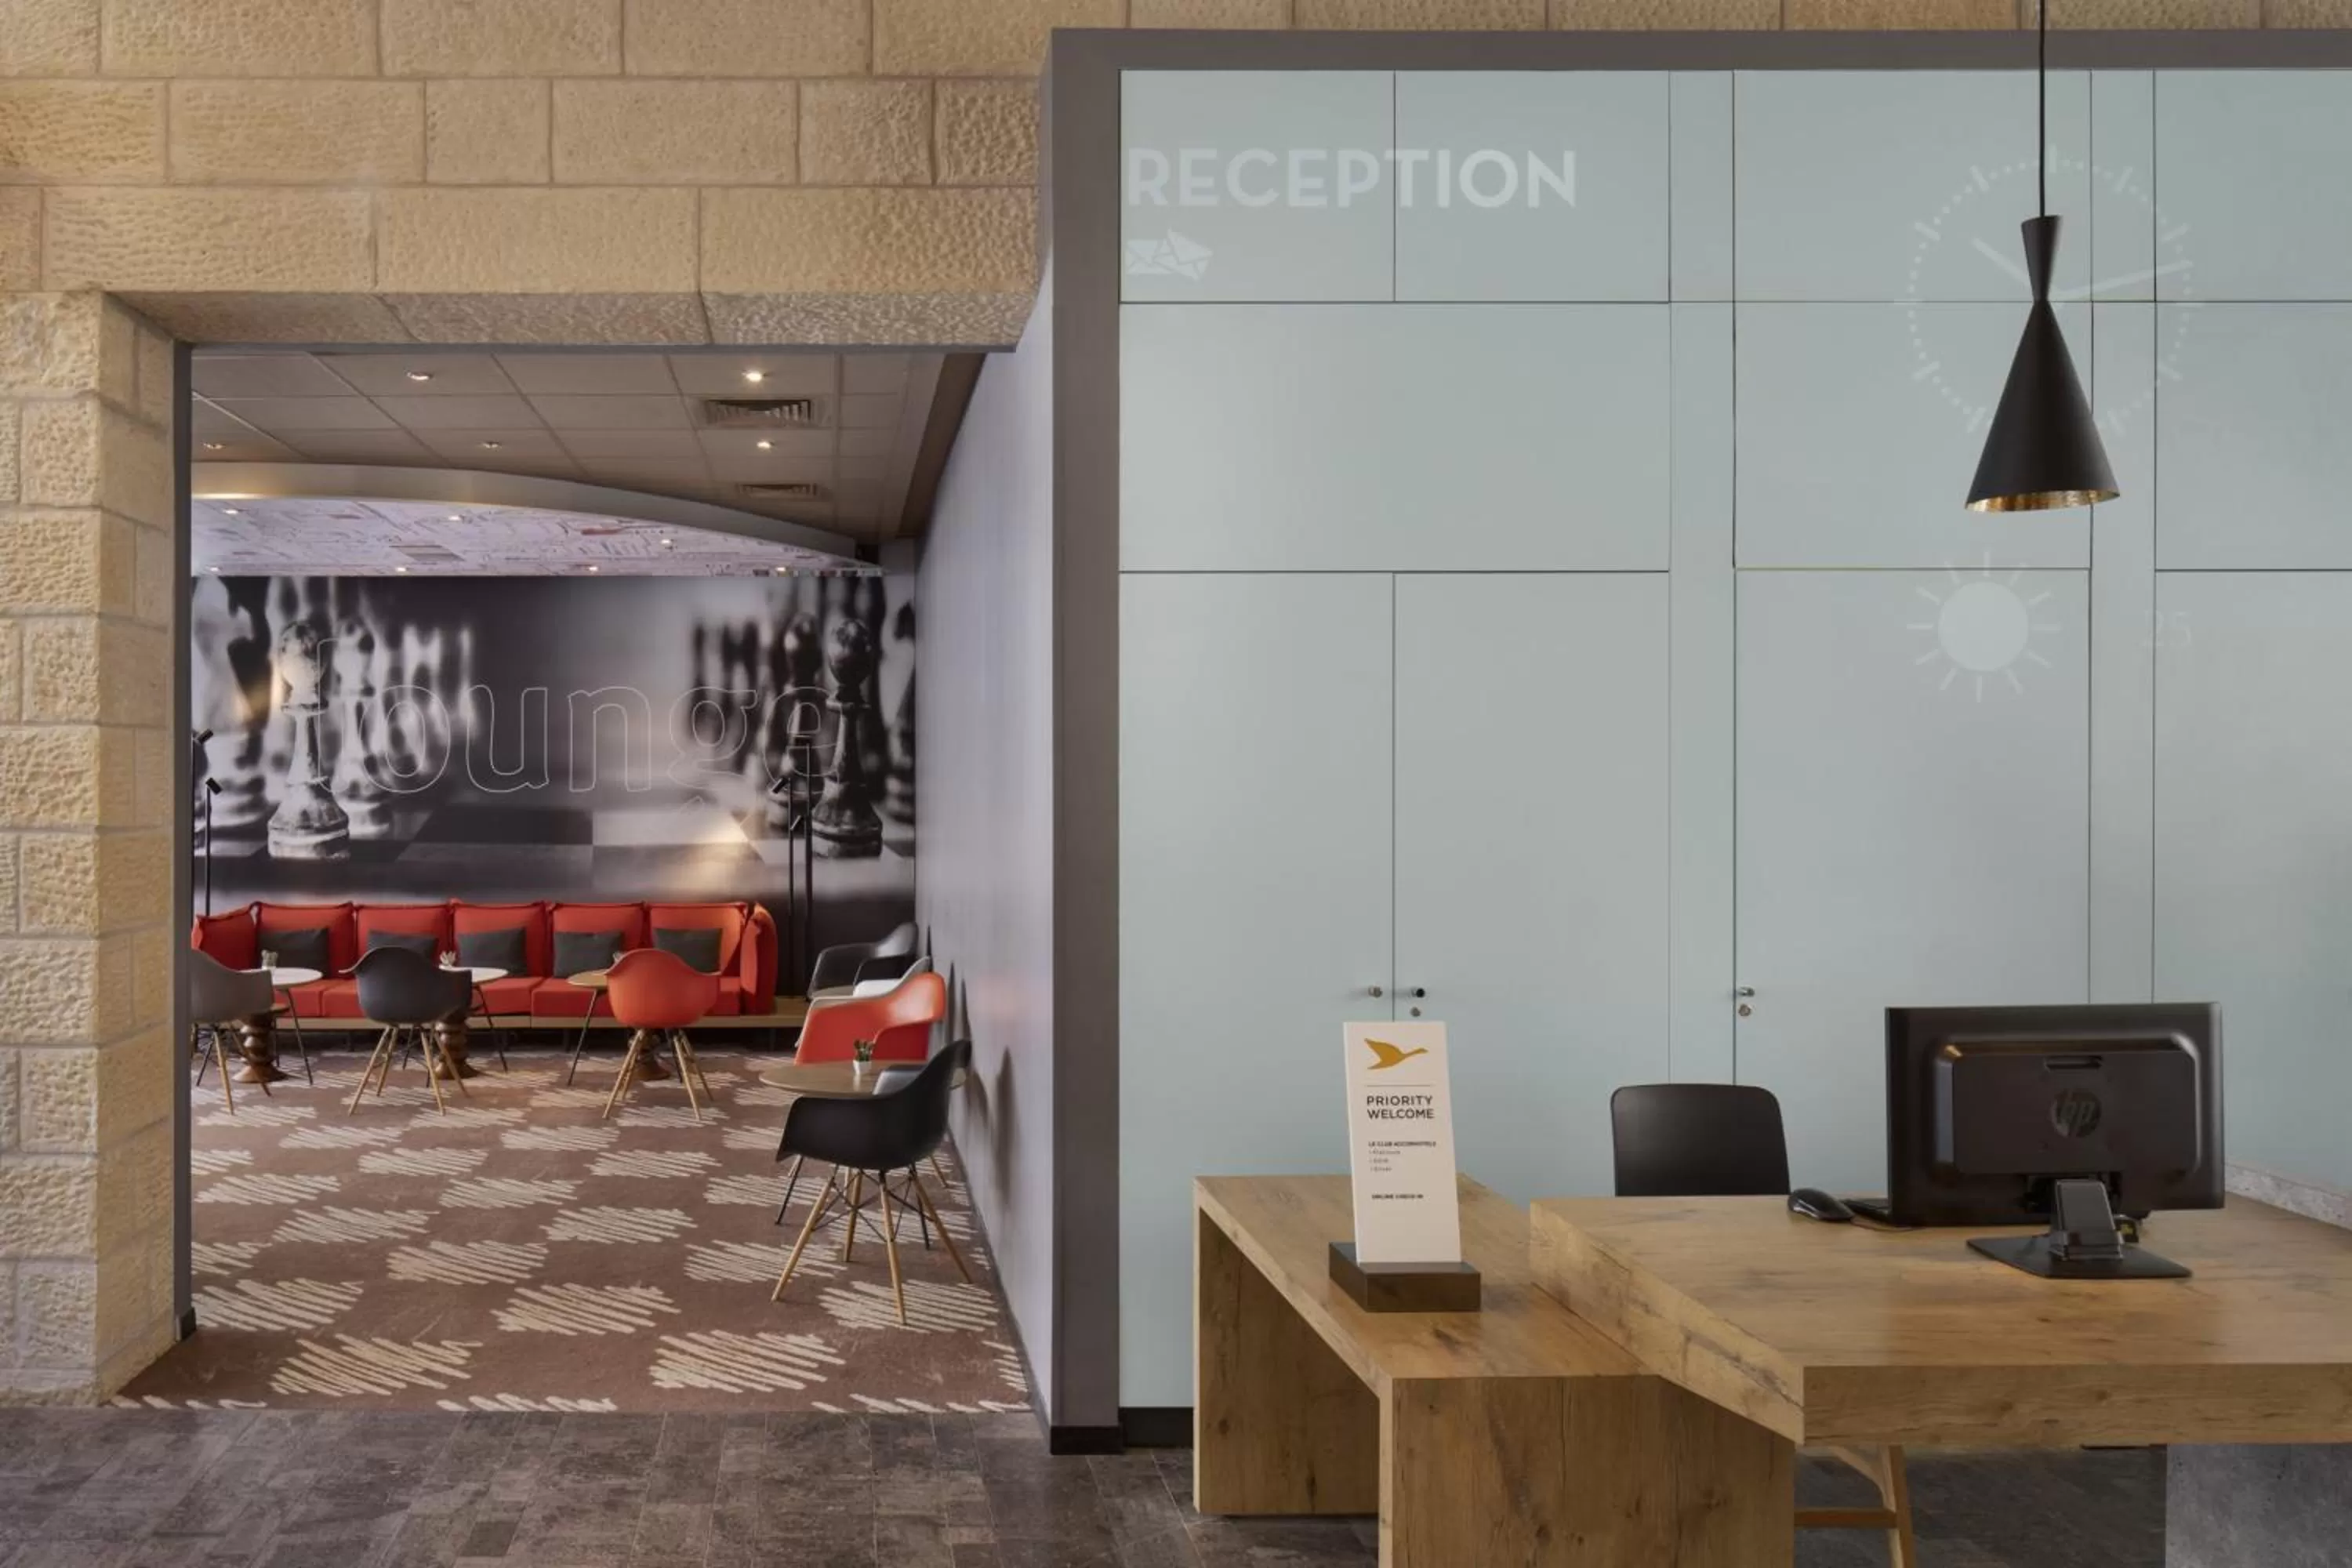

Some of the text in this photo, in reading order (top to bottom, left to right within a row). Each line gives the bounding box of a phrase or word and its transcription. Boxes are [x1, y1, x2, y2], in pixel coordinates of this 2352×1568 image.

[1127, 147, 1577, 209] RECEPTION
[1367, 1095, 1432, 1106] PRIORITY
[1367, 1108, 1435, 1120] WELCOME
[2056, 1087, 2098, 1138] hp
